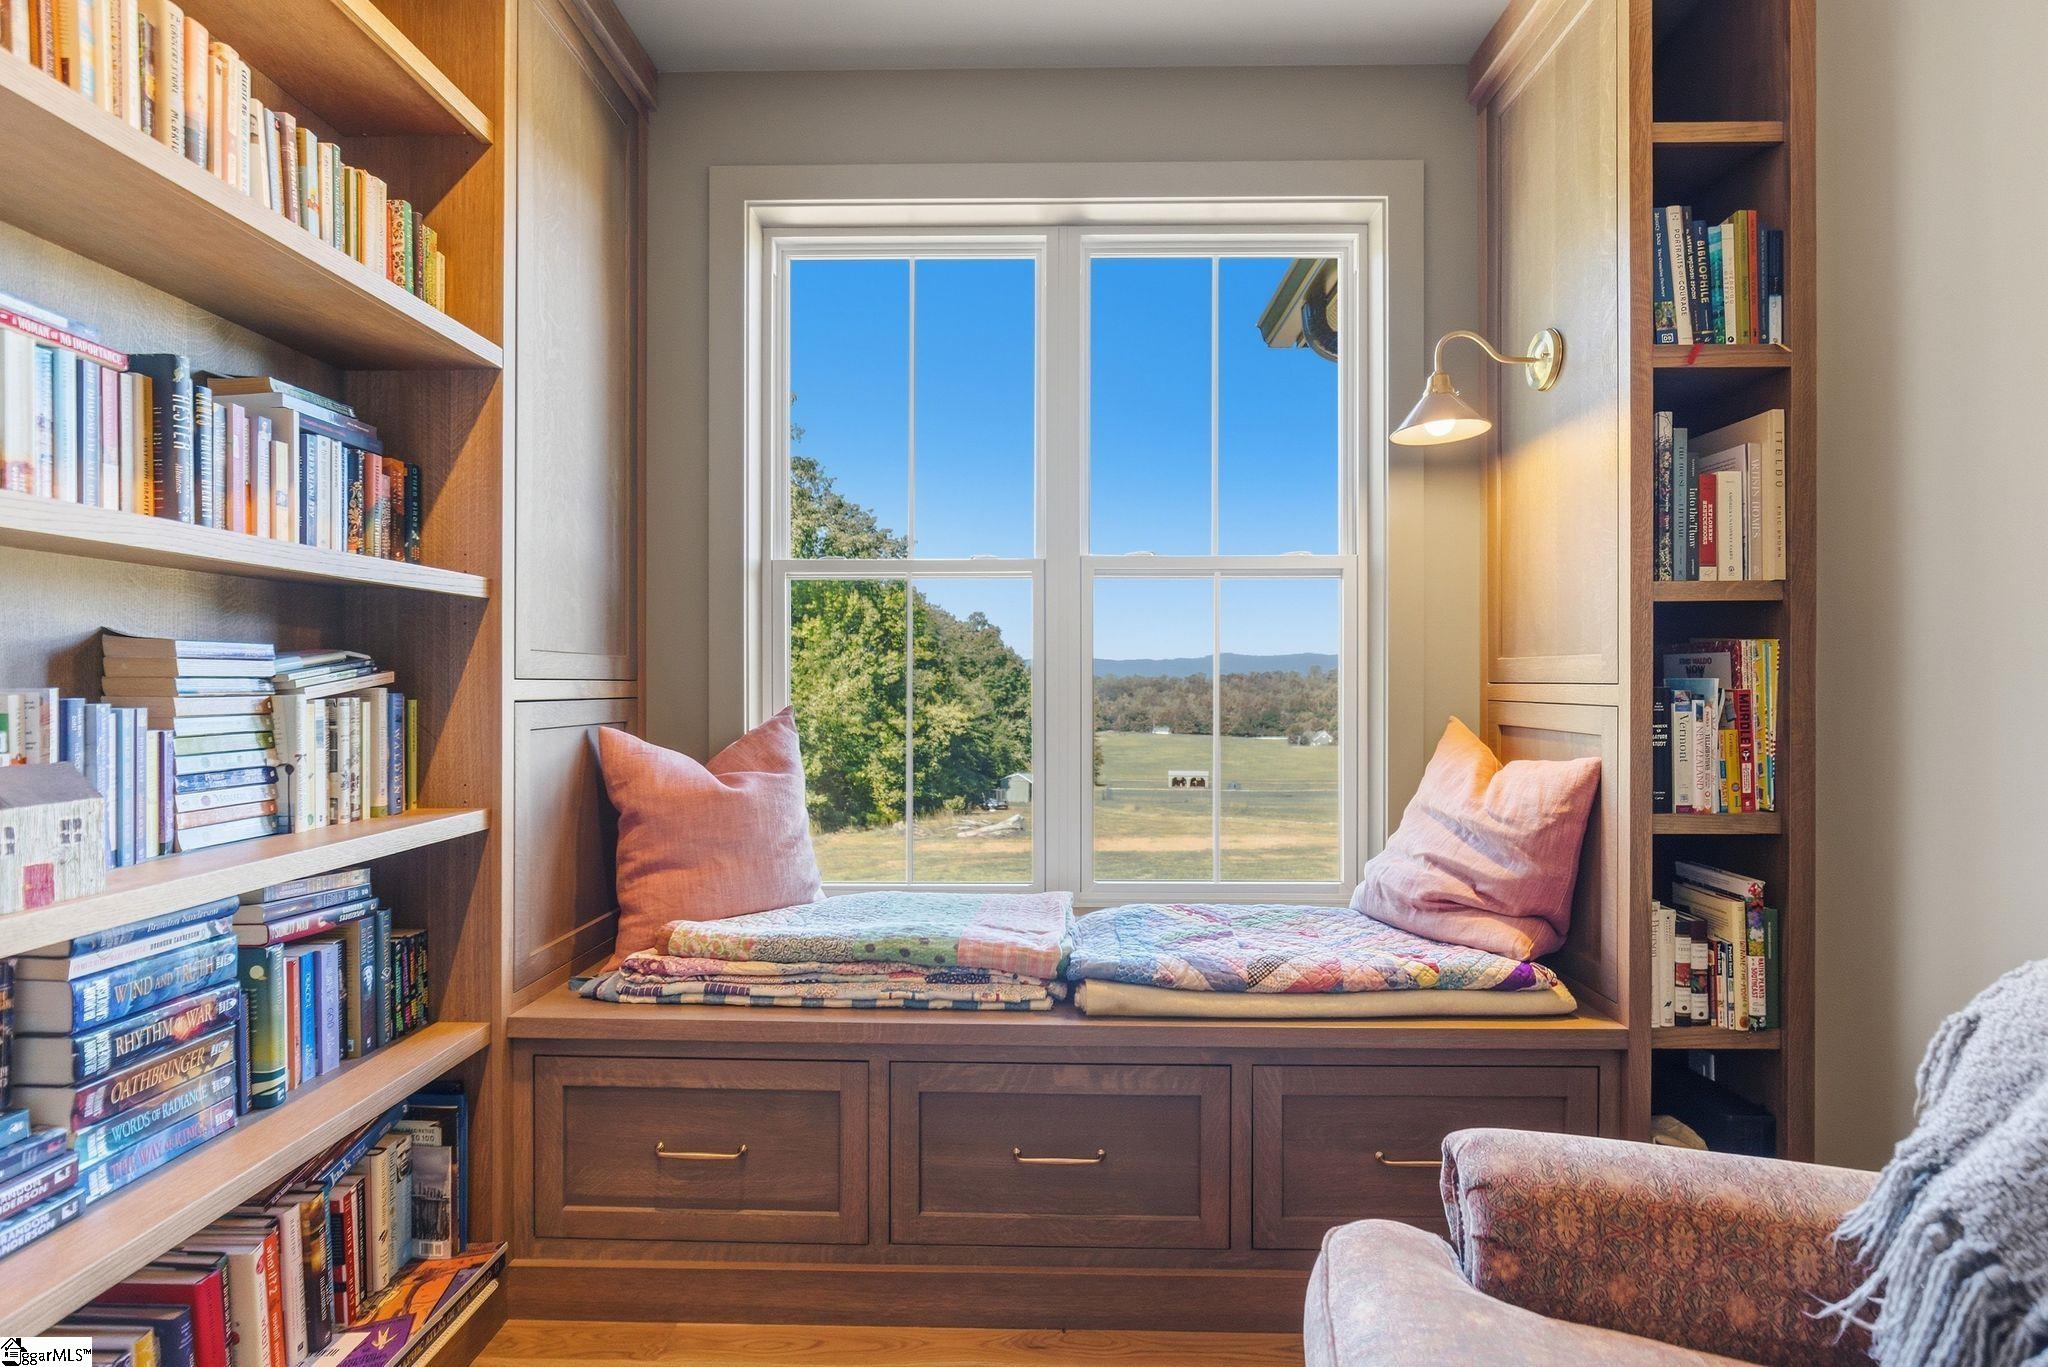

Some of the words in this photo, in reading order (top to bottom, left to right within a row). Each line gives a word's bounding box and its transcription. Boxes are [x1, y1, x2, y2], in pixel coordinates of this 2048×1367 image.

[1674, 228, 1683, 269] PORTRAITS
[1679, 280, 1688, 316] COURAGE
[1697, 240, 1709, 304] BIBLIOPHILE
[18, 316, 50, 340] WOMAN
[59, 332, 73, 349] NO
[73, 336, 123, 366] IMPORTANCE
[172, 393, 190, 453] HESTER
[196, 392, 212, 427] JAMES
[1689, 488, 1698, 506] Into
[1751, 501, 1761, 539] HOMES
[1689, 523, 1698, 548] Thaw
[1679, 713, 1689, 763] Vermont
[1696, 726, 1704, 748] NEW
[1738, 693, 1751, 746] MURDLE
[393, 728, 401, 794] WALDEN
[1696, 748, 1704, 791] ZEALAND
[296, 919, 309, 934] MAN
[114, 975, 154, 1004] WIND
[155, 972, 174, 990] AND
[174, 955, 216, 983] TRUTH
[115, 1017, 173, 1058] RHYTHM
[185, 1004, 213, 1028] WAR
[111, 1046, 206, 1104] OATHBRINGER
[111, 1110, 151, 1142] WORDS
[151, 1108, 162, 1122] OF
[162, 1084, 209, 1118] RADIANCE
[139, 1141, 164, 1167] WAY
[265, 1244, 275, 1268] what
[268, 1286, 279, 1297] 2
